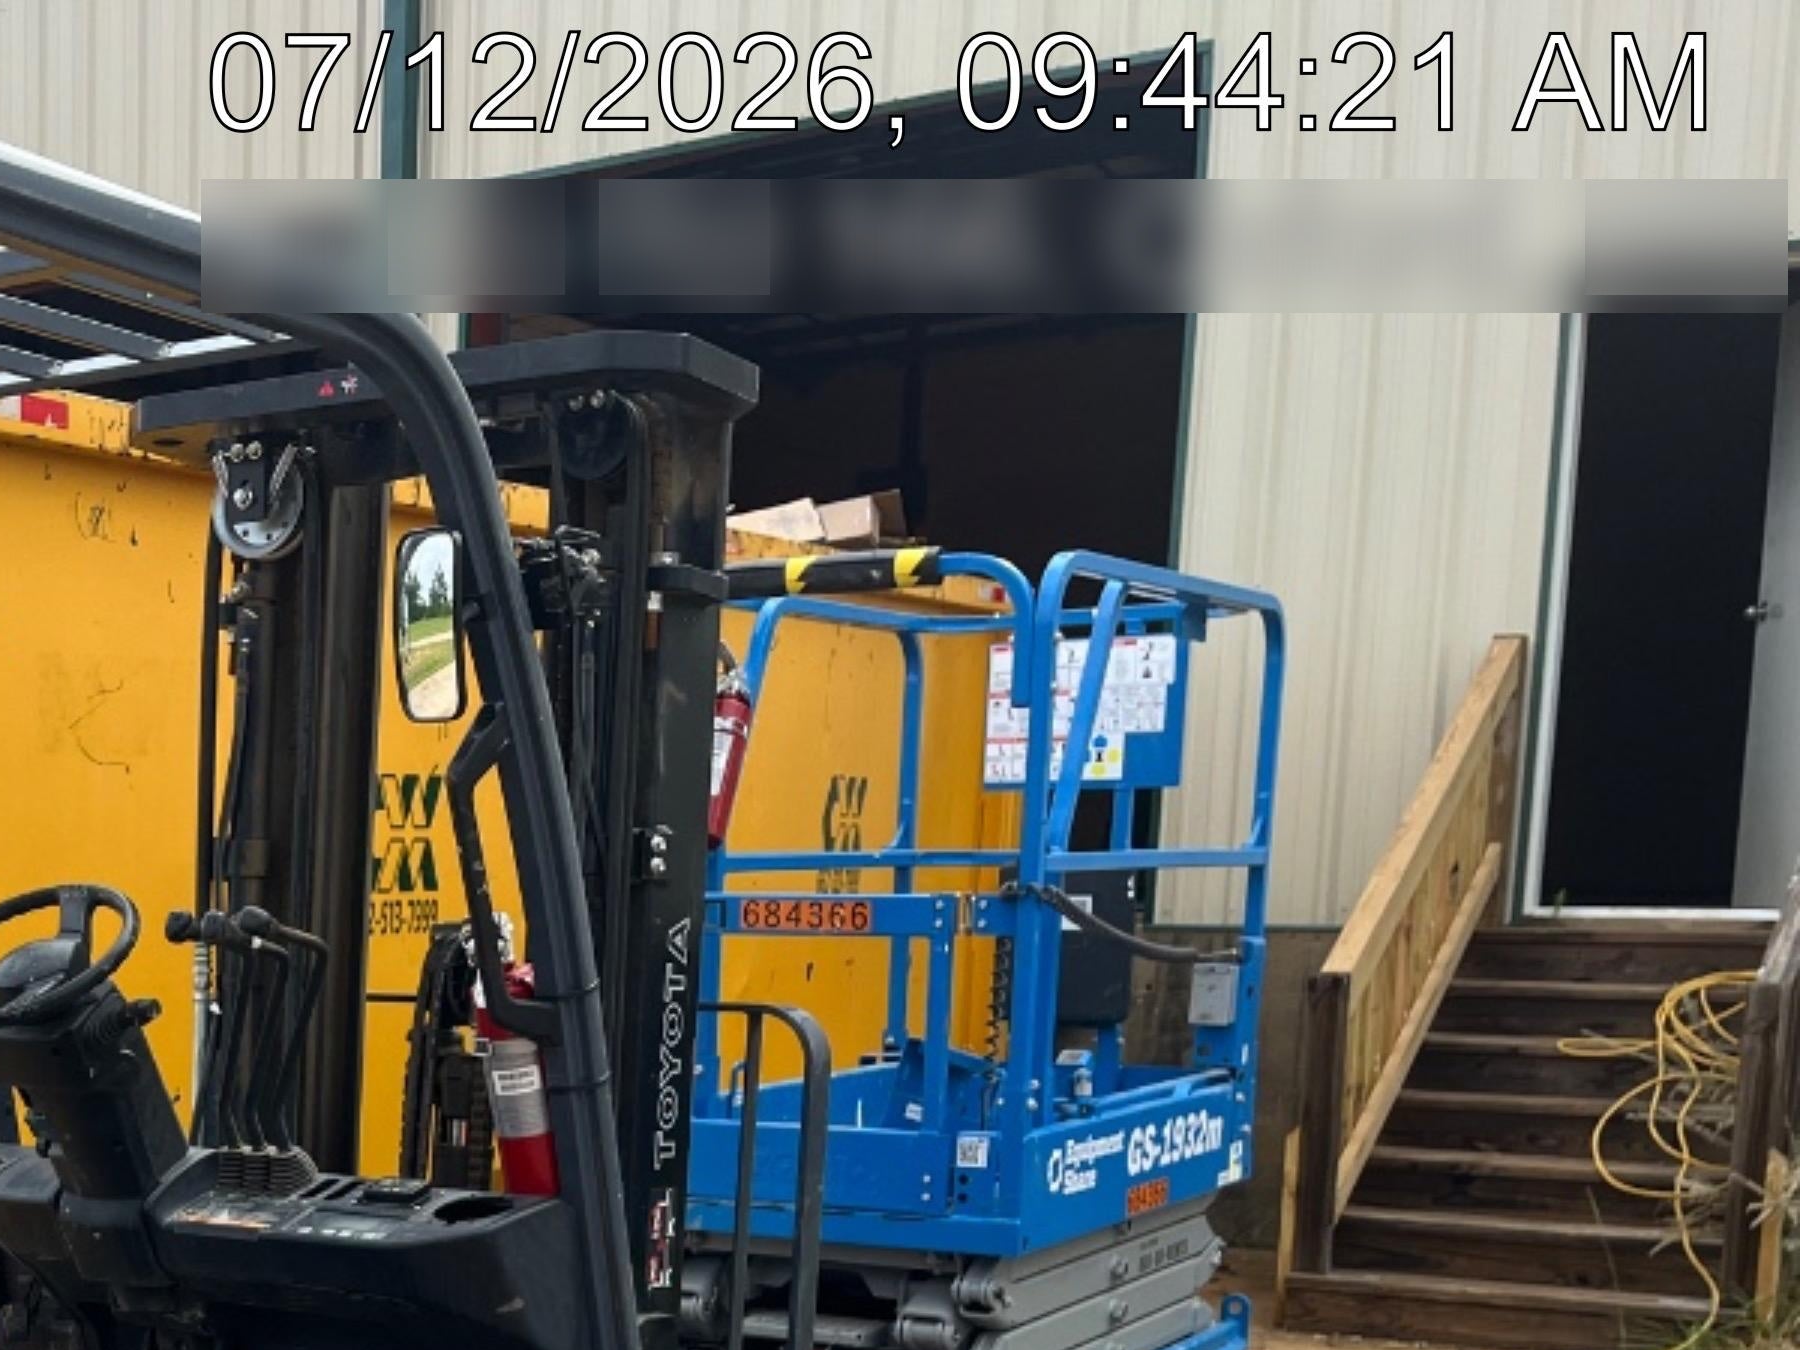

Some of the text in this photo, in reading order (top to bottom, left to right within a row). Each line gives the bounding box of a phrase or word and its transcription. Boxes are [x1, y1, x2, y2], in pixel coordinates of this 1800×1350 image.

[743, 901, 869, 931] 684366
[653, 917, 691, 1170] TOYOTA
[1127, 1109, 1223, 1177] GS-1932m
